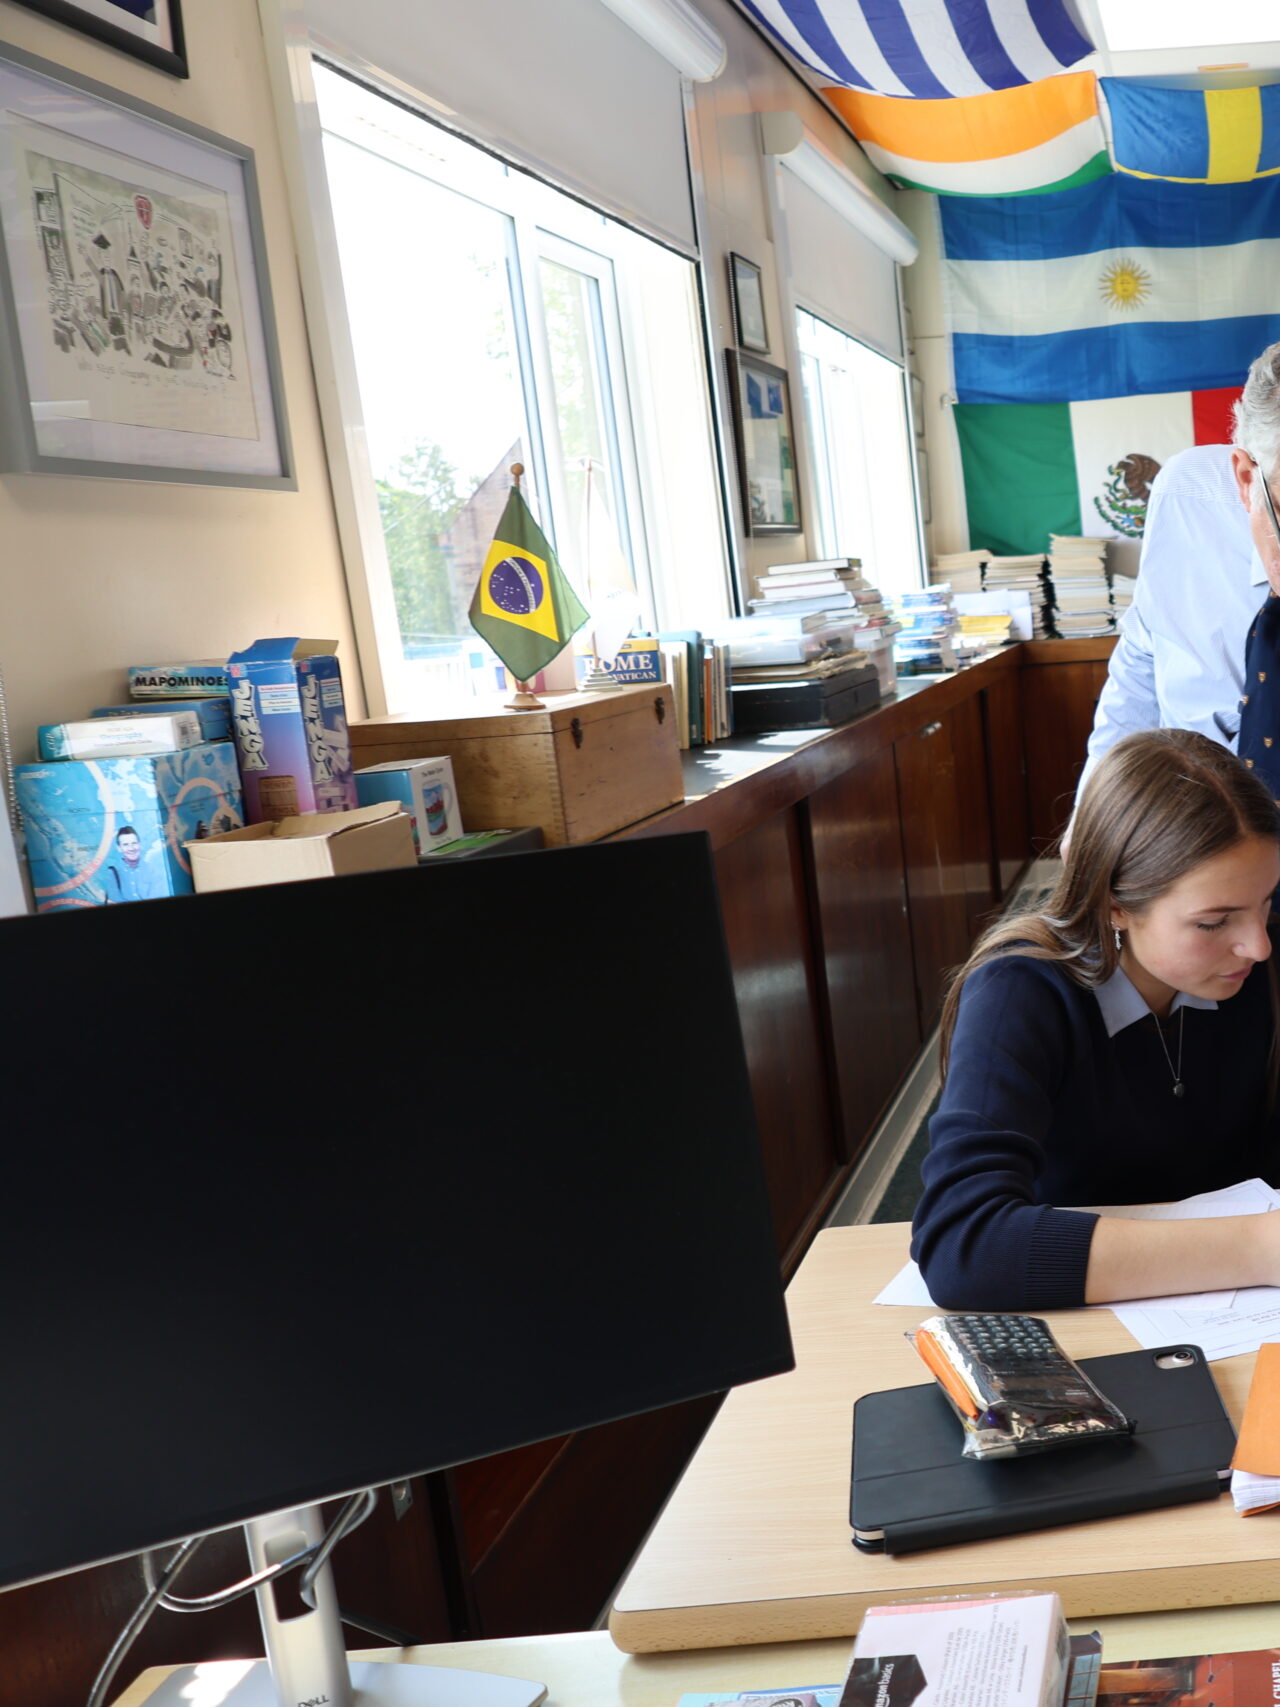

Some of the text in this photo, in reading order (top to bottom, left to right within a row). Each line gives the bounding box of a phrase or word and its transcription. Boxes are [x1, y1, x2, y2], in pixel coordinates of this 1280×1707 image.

[134, 676, 229, 687] MAPOMINOES
[231, 679, 269, 771] JENGA
[301, 675, 333, 784] JENGA
